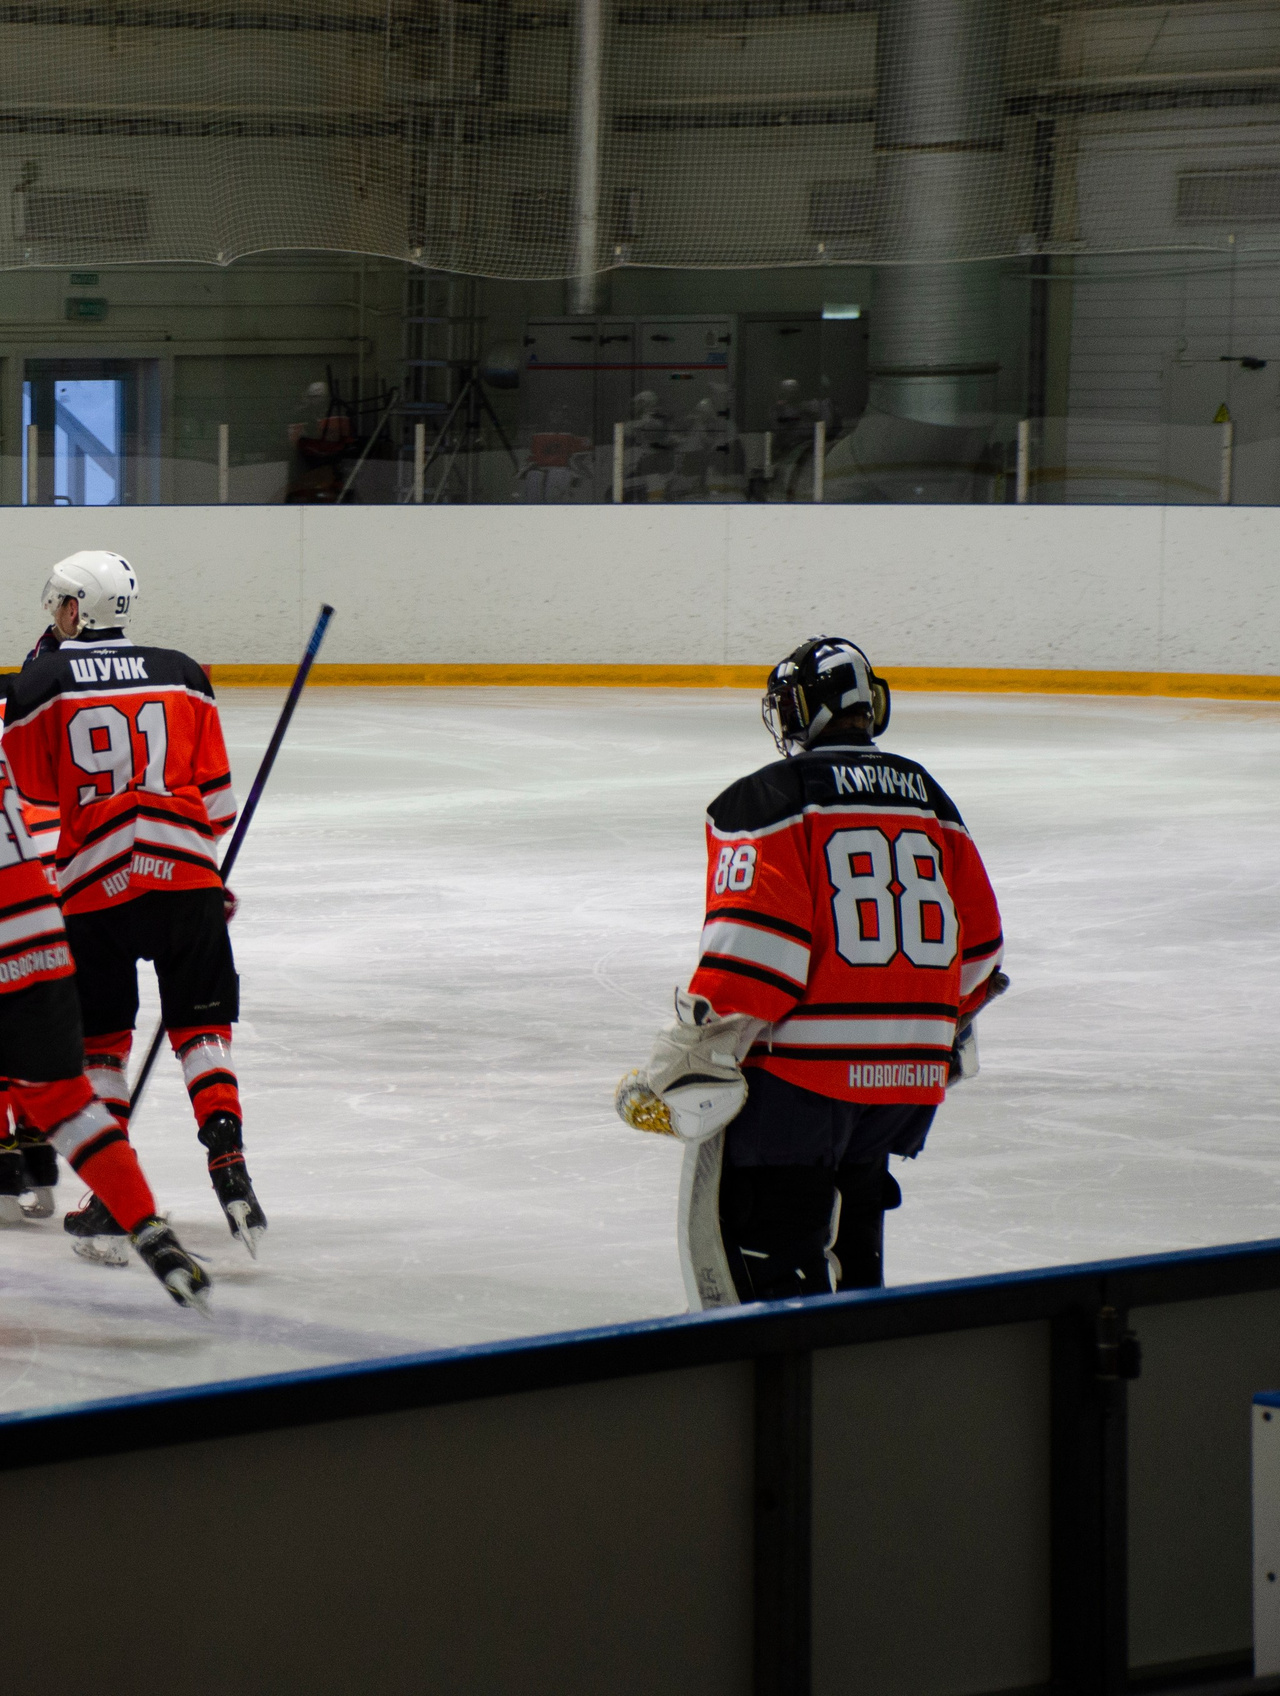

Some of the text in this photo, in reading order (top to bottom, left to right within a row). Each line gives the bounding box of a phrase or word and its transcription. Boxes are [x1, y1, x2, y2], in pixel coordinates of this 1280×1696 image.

[70, 657, 149, 683] ШУНК
[67, 701, 173, 806] 91
[832, 765, 928, 802] КИРИЧКО
[714, 844, 757, 895] 88
[824, 826, 960, 968] 88
